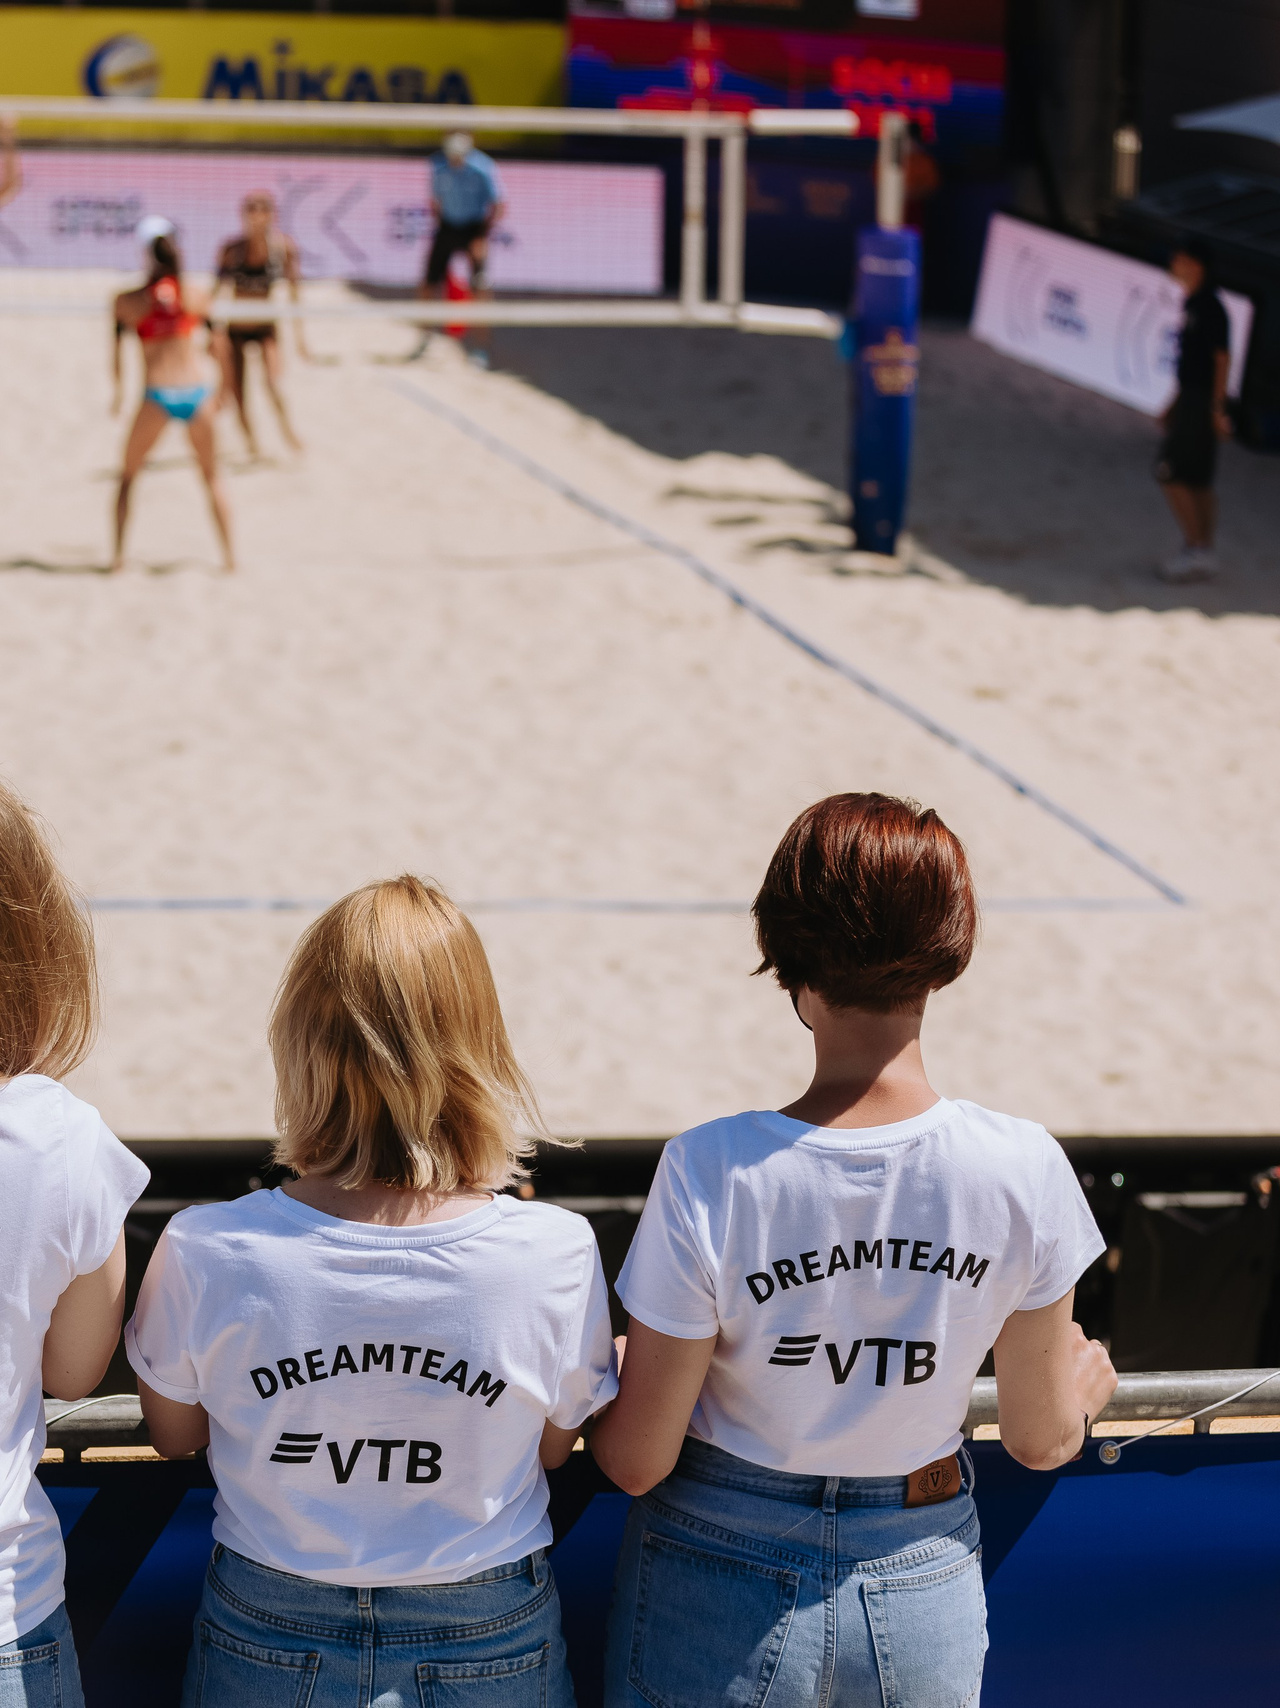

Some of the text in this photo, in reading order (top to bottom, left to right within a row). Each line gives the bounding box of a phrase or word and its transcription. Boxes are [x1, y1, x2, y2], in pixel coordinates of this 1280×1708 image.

[745, 1238, 991, 1305] DREAMTEAM
[249, 1343, 508, 1408] DREAMTEAM
[824, 1337, 937, 1387] VTB
[326, 1438, 443, 1485] VTB
[929, 1470, 941, 1488] V
